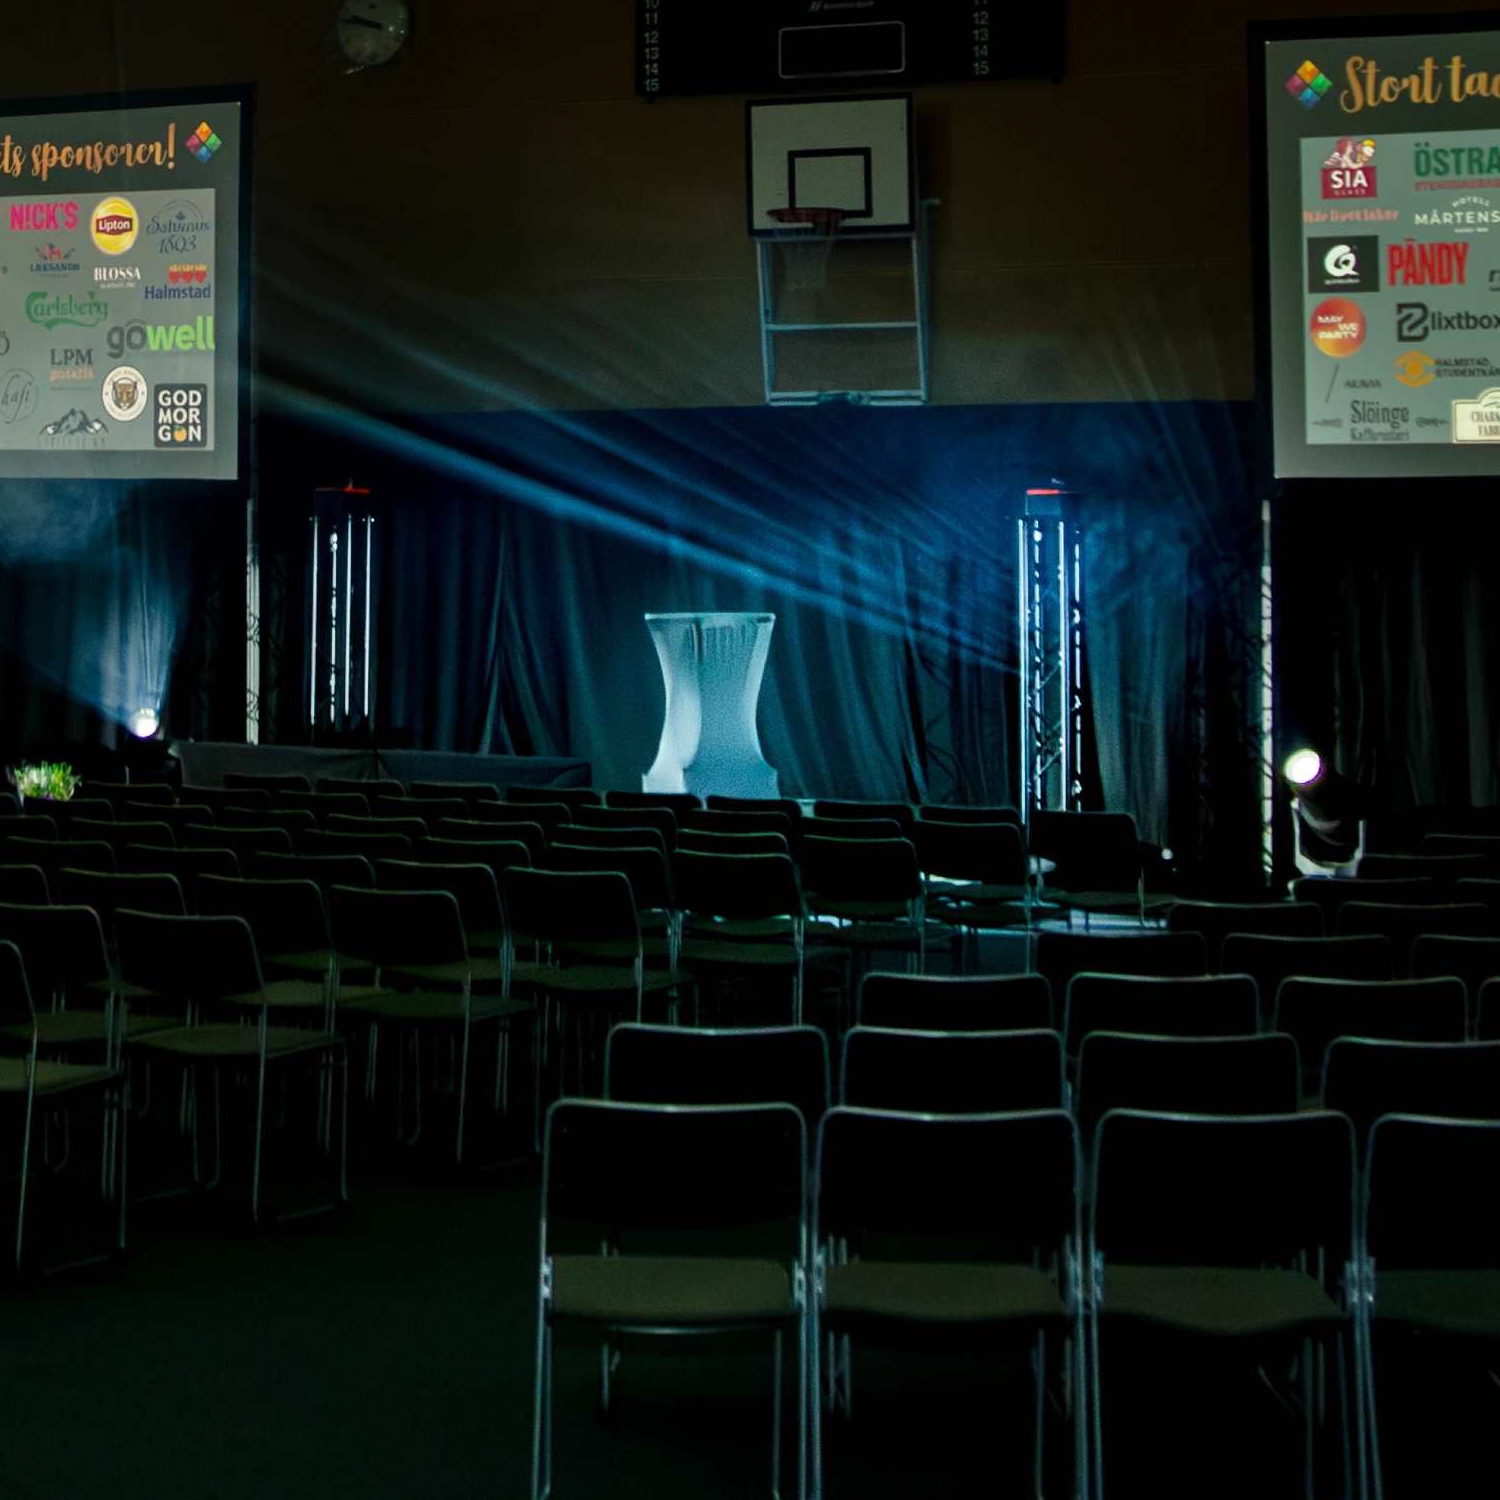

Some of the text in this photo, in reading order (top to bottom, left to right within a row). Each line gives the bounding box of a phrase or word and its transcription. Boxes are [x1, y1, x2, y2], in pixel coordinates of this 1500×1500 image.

[644, 12, 659, 26] 11
[972, 11, 989, 25] 12
[643, 30, 659, 44] 12
[644, 46, 659, 61] 13
[644, 61, 659, 76] 14
[643, 77, 660, 92] 15
[1340, 55, 1442, 113] Stort
[31, 122, 176, 182] sponsorer!
[1330, 169, 1368, 189] SIA
[98, 220, 131, 232] Lipton
[159, 234, 197, 254] 1893
[94, 266, 142, 281] BLOSSA
[144, 283, 211, 300] Halmstad
[25, 291, 108, 331] Carlsberg
[106, 315, 216, 359] gowell
[51, 348, 94, 366] LPM
[158, 389, 202, 407] GOD
[158, 407, 201, 425] MOR
[1351, 400, 1410, 428] Slöinge
